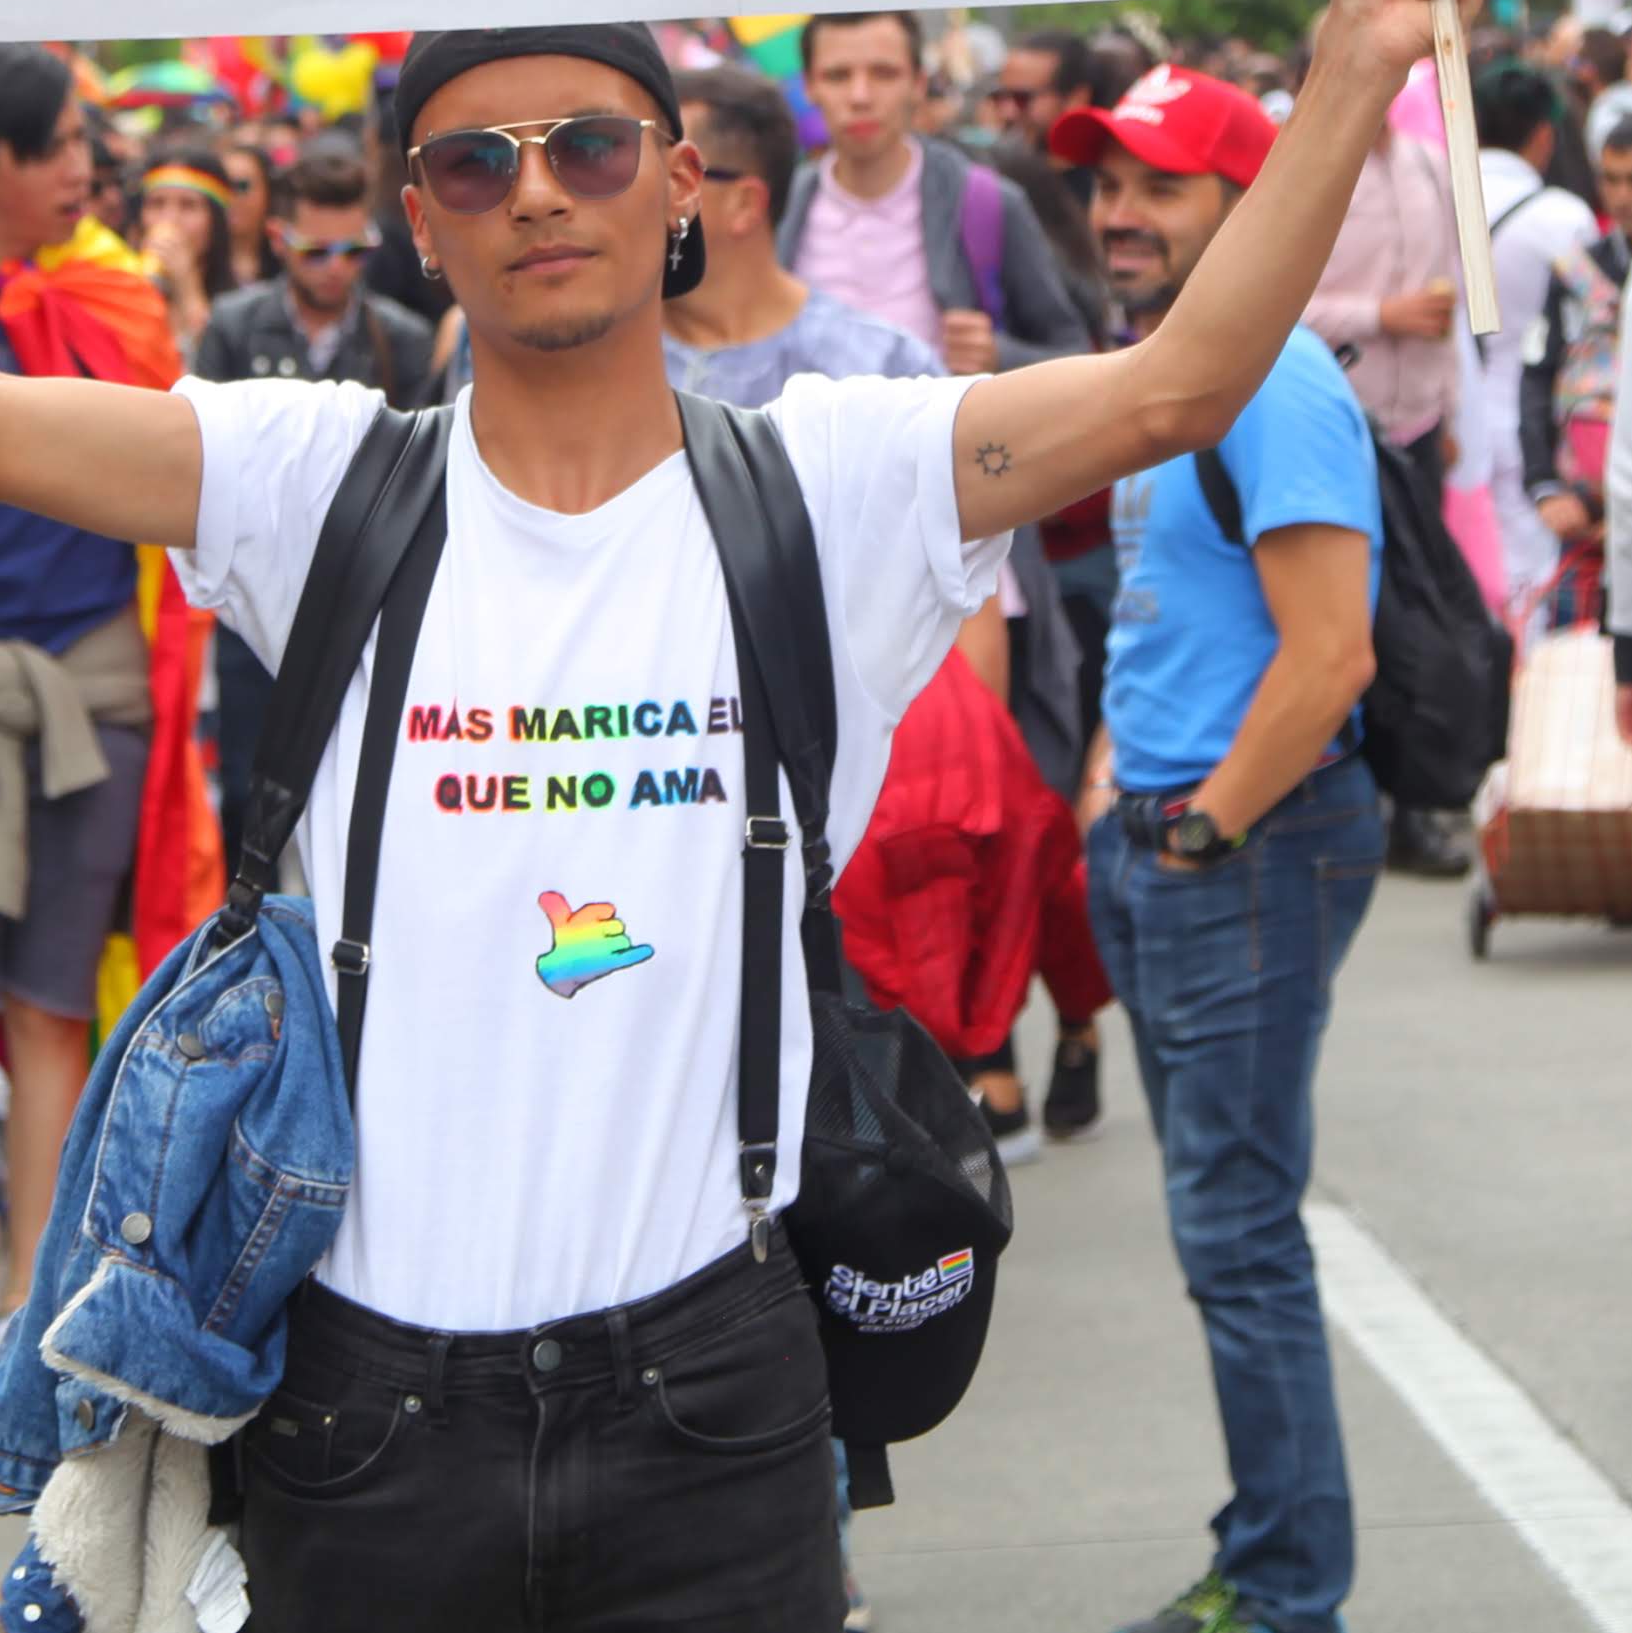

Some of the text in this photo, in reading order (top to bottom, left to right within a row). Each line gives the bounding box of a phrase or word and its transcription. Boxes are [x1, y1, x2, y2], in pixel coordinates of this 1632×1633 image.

[508, 700, 699, 741] MARICA
[434, 766, 727, 815] QUE NO AMA
[831, 1262, 938, 1300] Siente
[867, 1279, 967, 1317] Placer
